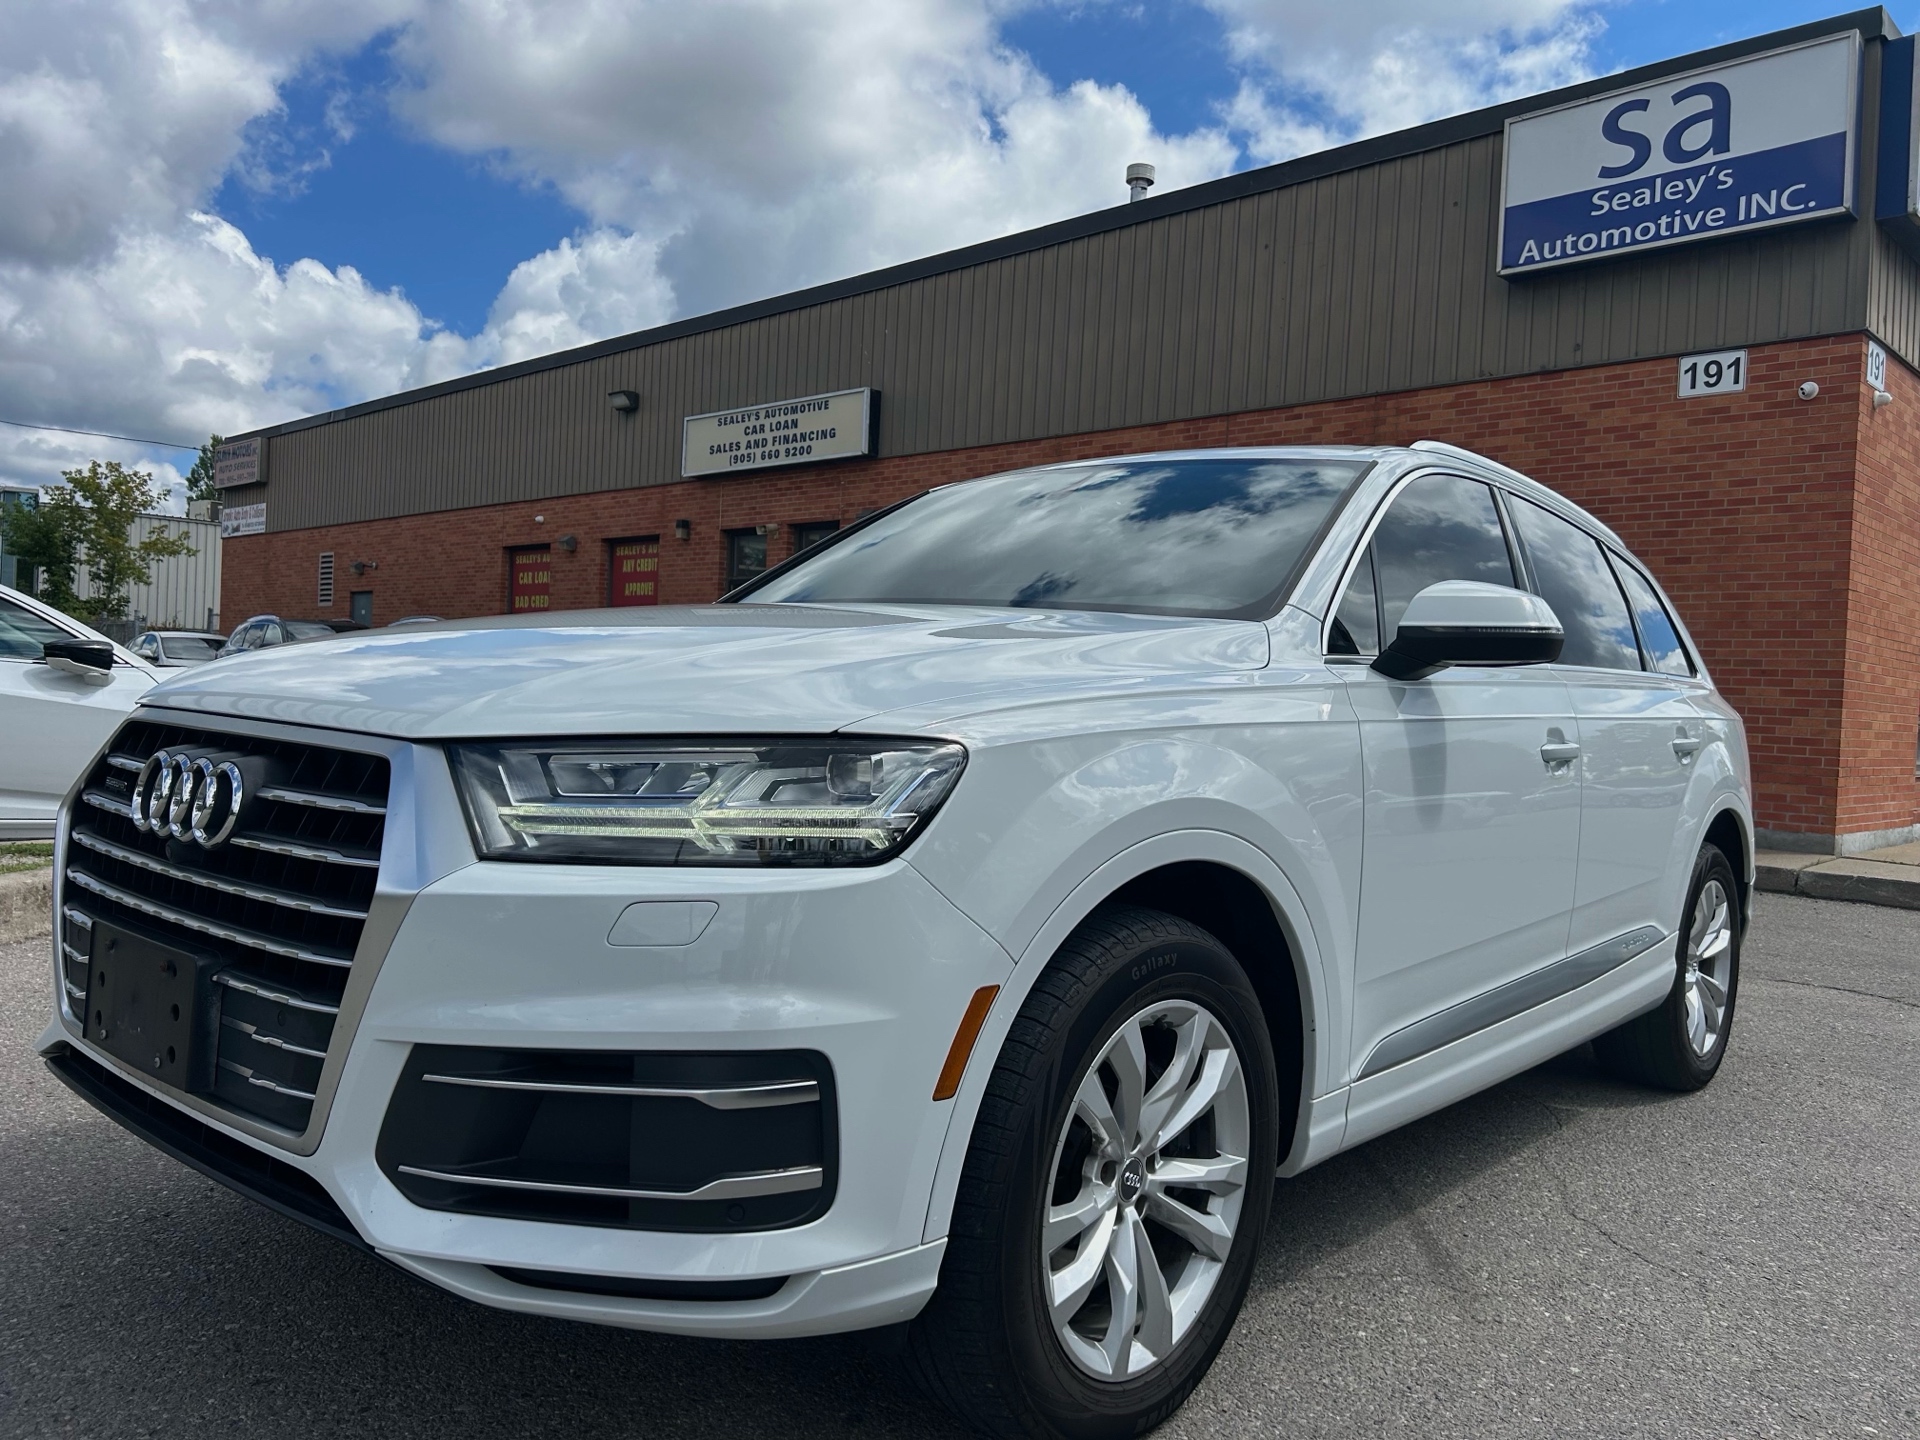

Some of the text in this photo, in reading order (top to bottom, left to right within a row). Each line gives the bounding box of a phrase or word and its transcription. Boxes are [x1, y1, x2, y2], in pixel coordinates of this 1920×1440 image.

[1597, 81, 1732, 179] sa
[1590, 165, 1734, 217] Sealey's
[1518, 183, 1816, 265] Automotive INC.
[1683, 356, 1742, 391] 191
[1869, 347, 1885, 384] 191
[717, 400, 830, 427] SEALEY'S AUTOMOTIVE
[744, 418, 799, 436] CAR LOAN
[709, 427, 836, 455] SALES AND FINANCING
[729, 444, 812, 466] (905) 660 9200
[519, 572, 533, 585] CAR
[623, 557, 658, 573] ANY CREDIT
[514, 595, 530, 608] BAD
[1131, 952, 1178, 981] Gallaxy
